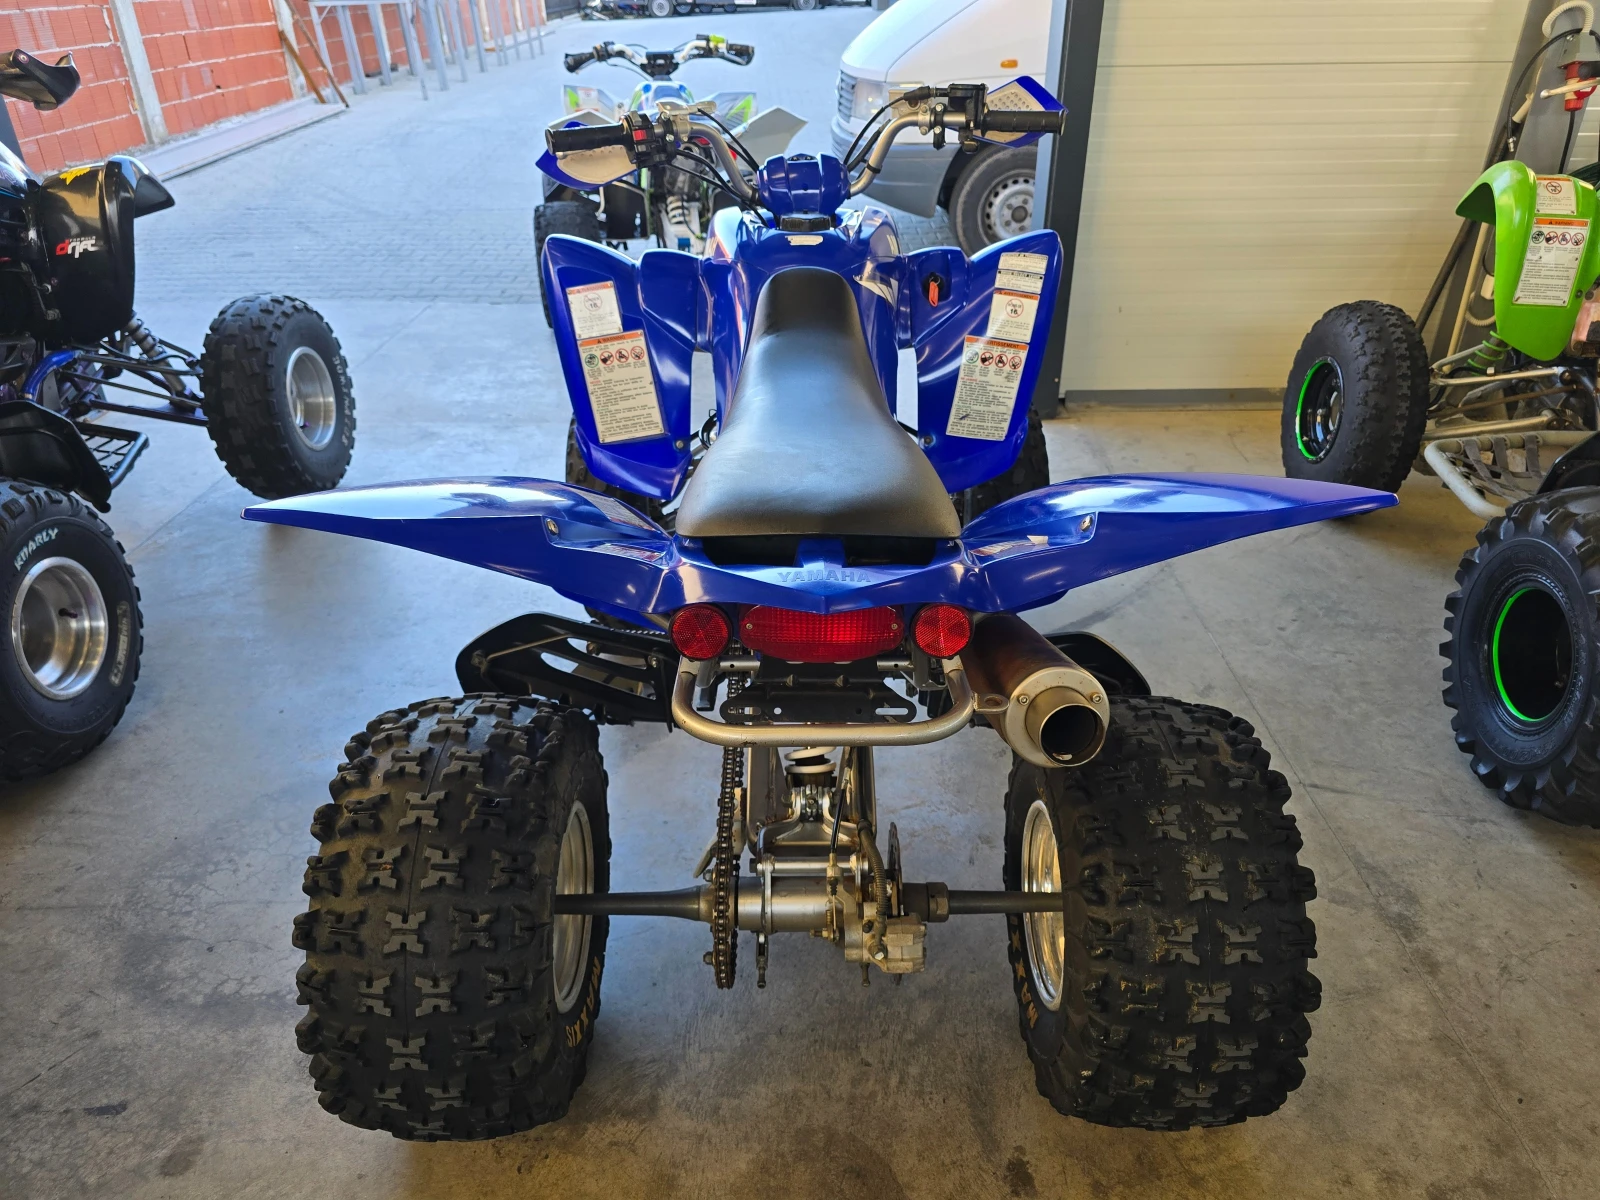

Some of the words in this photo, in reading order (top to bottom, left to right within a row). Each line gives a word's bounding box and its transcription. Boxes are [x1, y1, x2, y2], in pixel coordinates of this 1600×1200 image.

[777, 569, 872, 583] YAMAHA
[565, 955, 601, 1048] MAXXIS
[1010, 915, 1039, 1029] MAXXI
